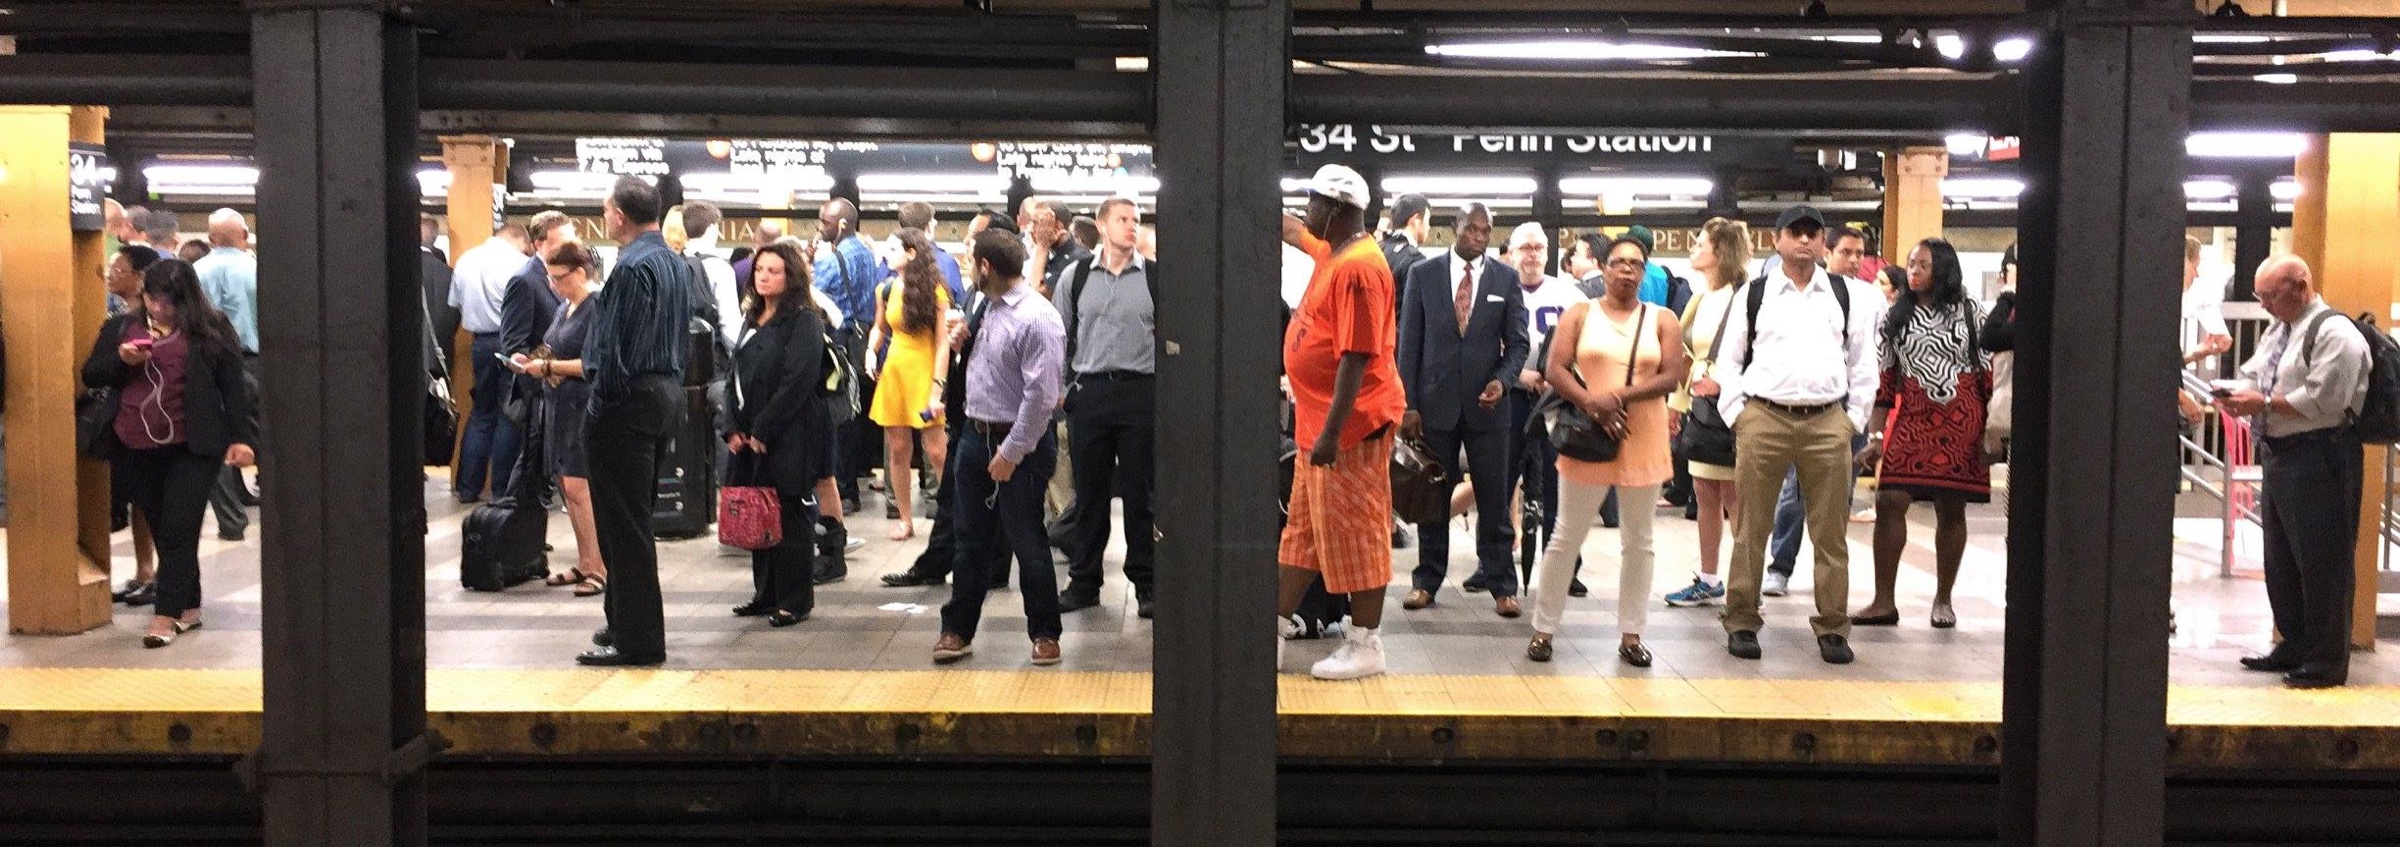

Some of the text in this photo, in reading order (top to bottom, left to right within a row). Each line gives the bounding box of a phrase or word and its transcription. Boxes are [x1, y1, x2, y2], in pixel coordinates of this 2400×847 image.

[1300, 123, 1357, 152] 34
[1370, 124, 1416, 152] St
[1566, 134, 1712, 153] Station
